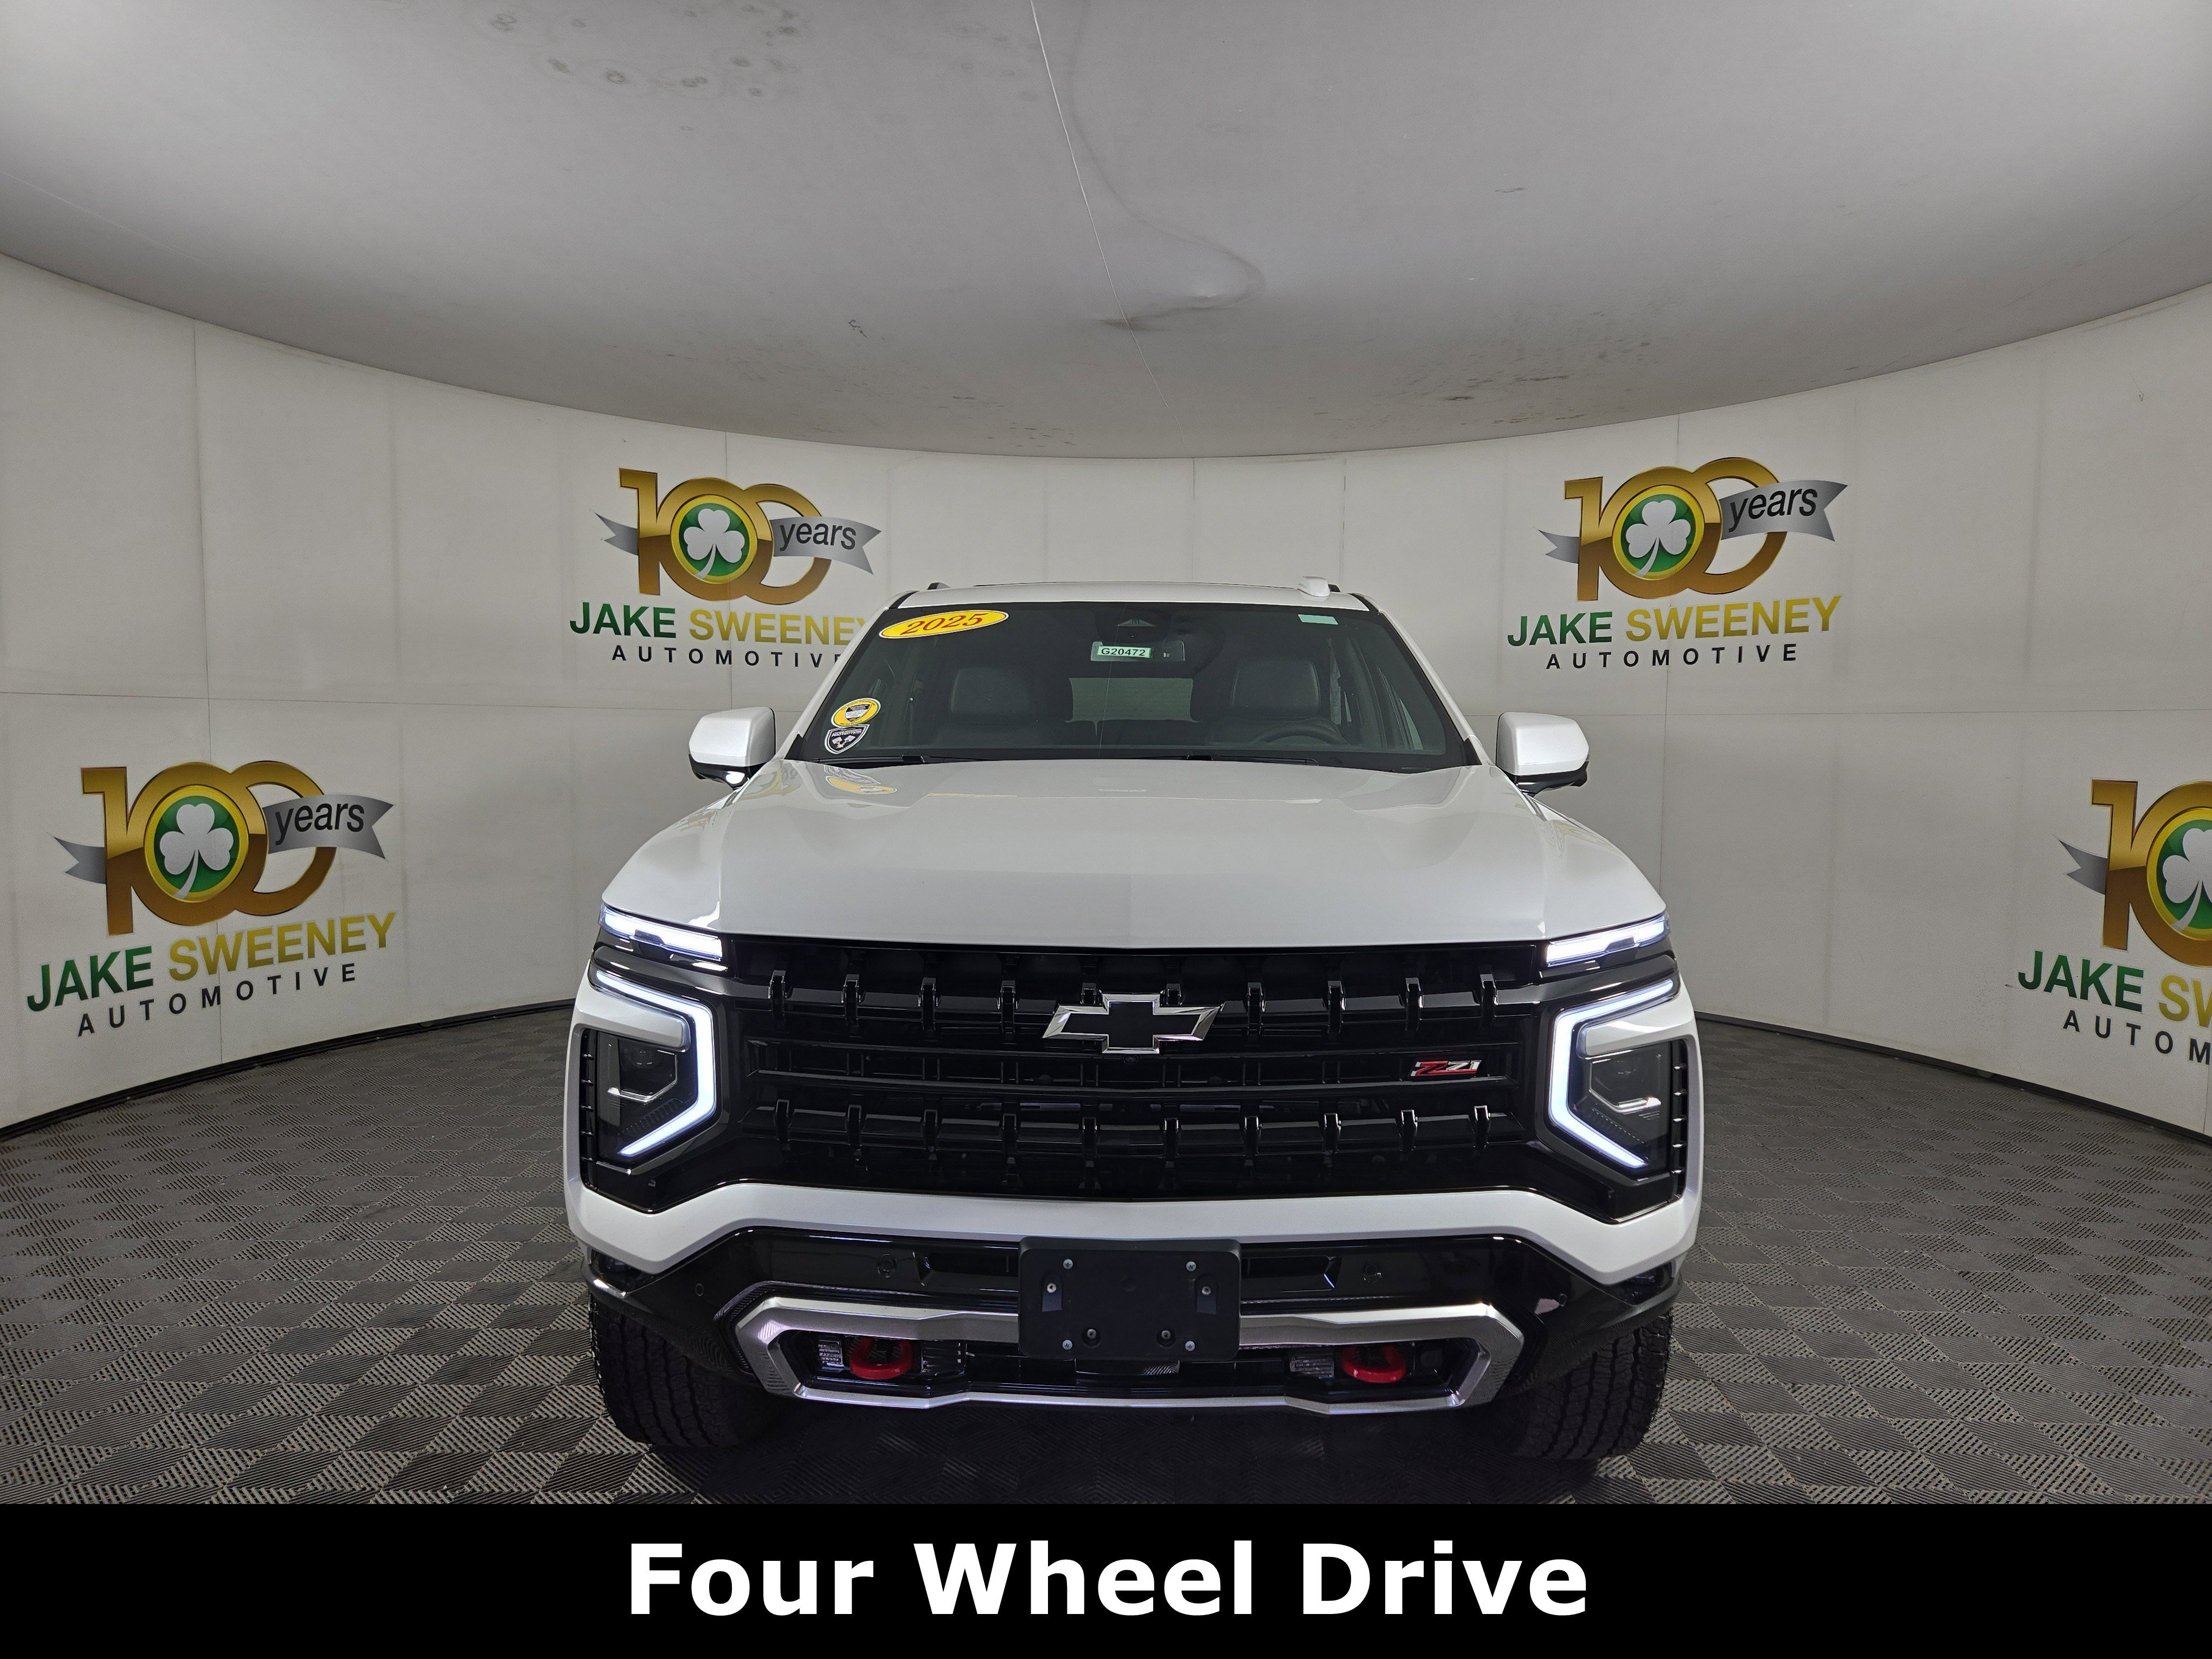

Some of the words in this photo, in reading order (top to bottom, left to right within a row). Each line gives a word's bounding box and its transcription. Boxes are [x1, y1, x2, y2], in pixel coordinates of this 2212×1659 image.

[1564, 456, 1788, 601] 100
[1727, 488, 1818, 532] years
[619, 467, 832, 605] 100
[780, 522, 857, 551] years
[569, 601, 676, 638] JAKE
[689, 609, 865, 645] SWEENE
[899, 613, 988, 635] 2025
[1507, 612, 1613, 647] JAKE
[1626, 595, 1842, 642] SWEENEY
[612, 645, 841, 668] AUTOMOTIV
[1101, 648, 1146, 656] G20472
[1546, 644, 1797, 669] AUTOMOTIVE
[274, 801, 365, 846] years
[80, 760, 337, 937] 100
[27, 946, 154, 1013] JAKE
[169, 912, 396, 981] SWEENEY
[2018, 950, 2144, 1013] JAKE
[78, 963, 356, 1037] AUTOMOTIVE
[1410, 1060, 1482, 1076] Z71
